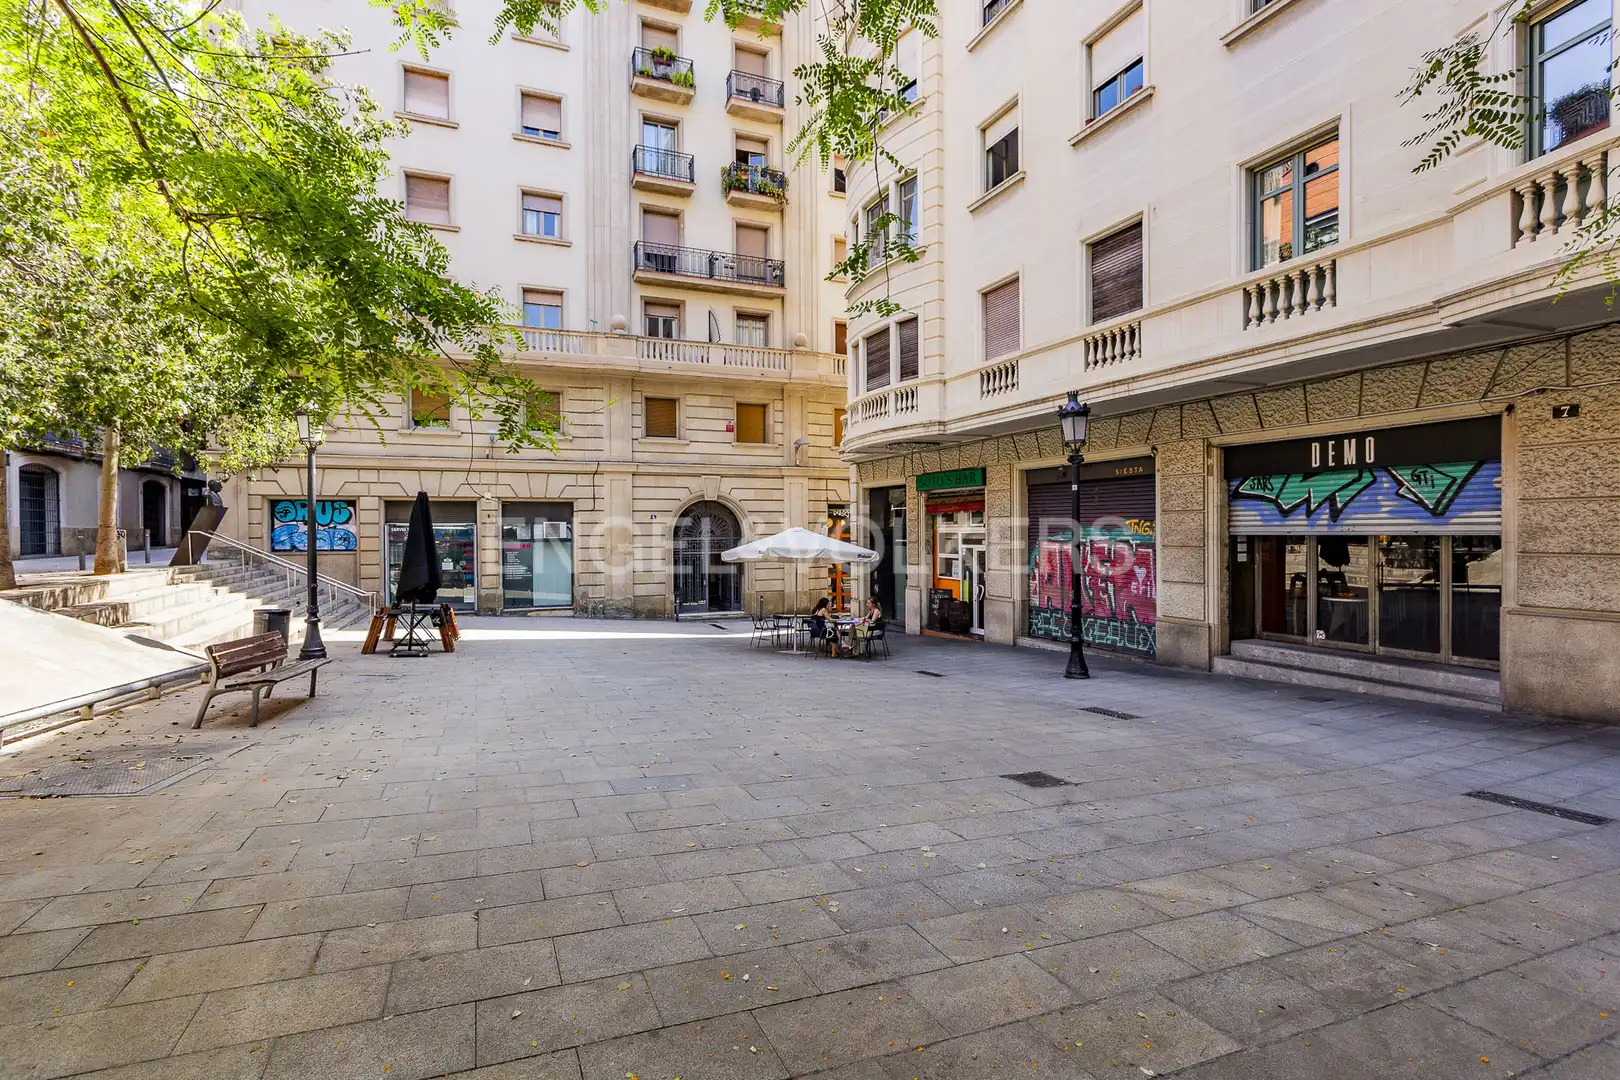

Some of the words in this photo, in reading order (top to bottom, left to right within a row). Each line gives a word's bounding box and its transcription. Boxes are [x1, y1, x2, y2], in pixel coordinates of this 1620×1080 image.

[1560, 405, 1570, 418] 7
[1311, 436, 1375, 468] DEMO
[1115, 466, 1144, 476] SIESTA
[955, 471, 977, 485] BAR
